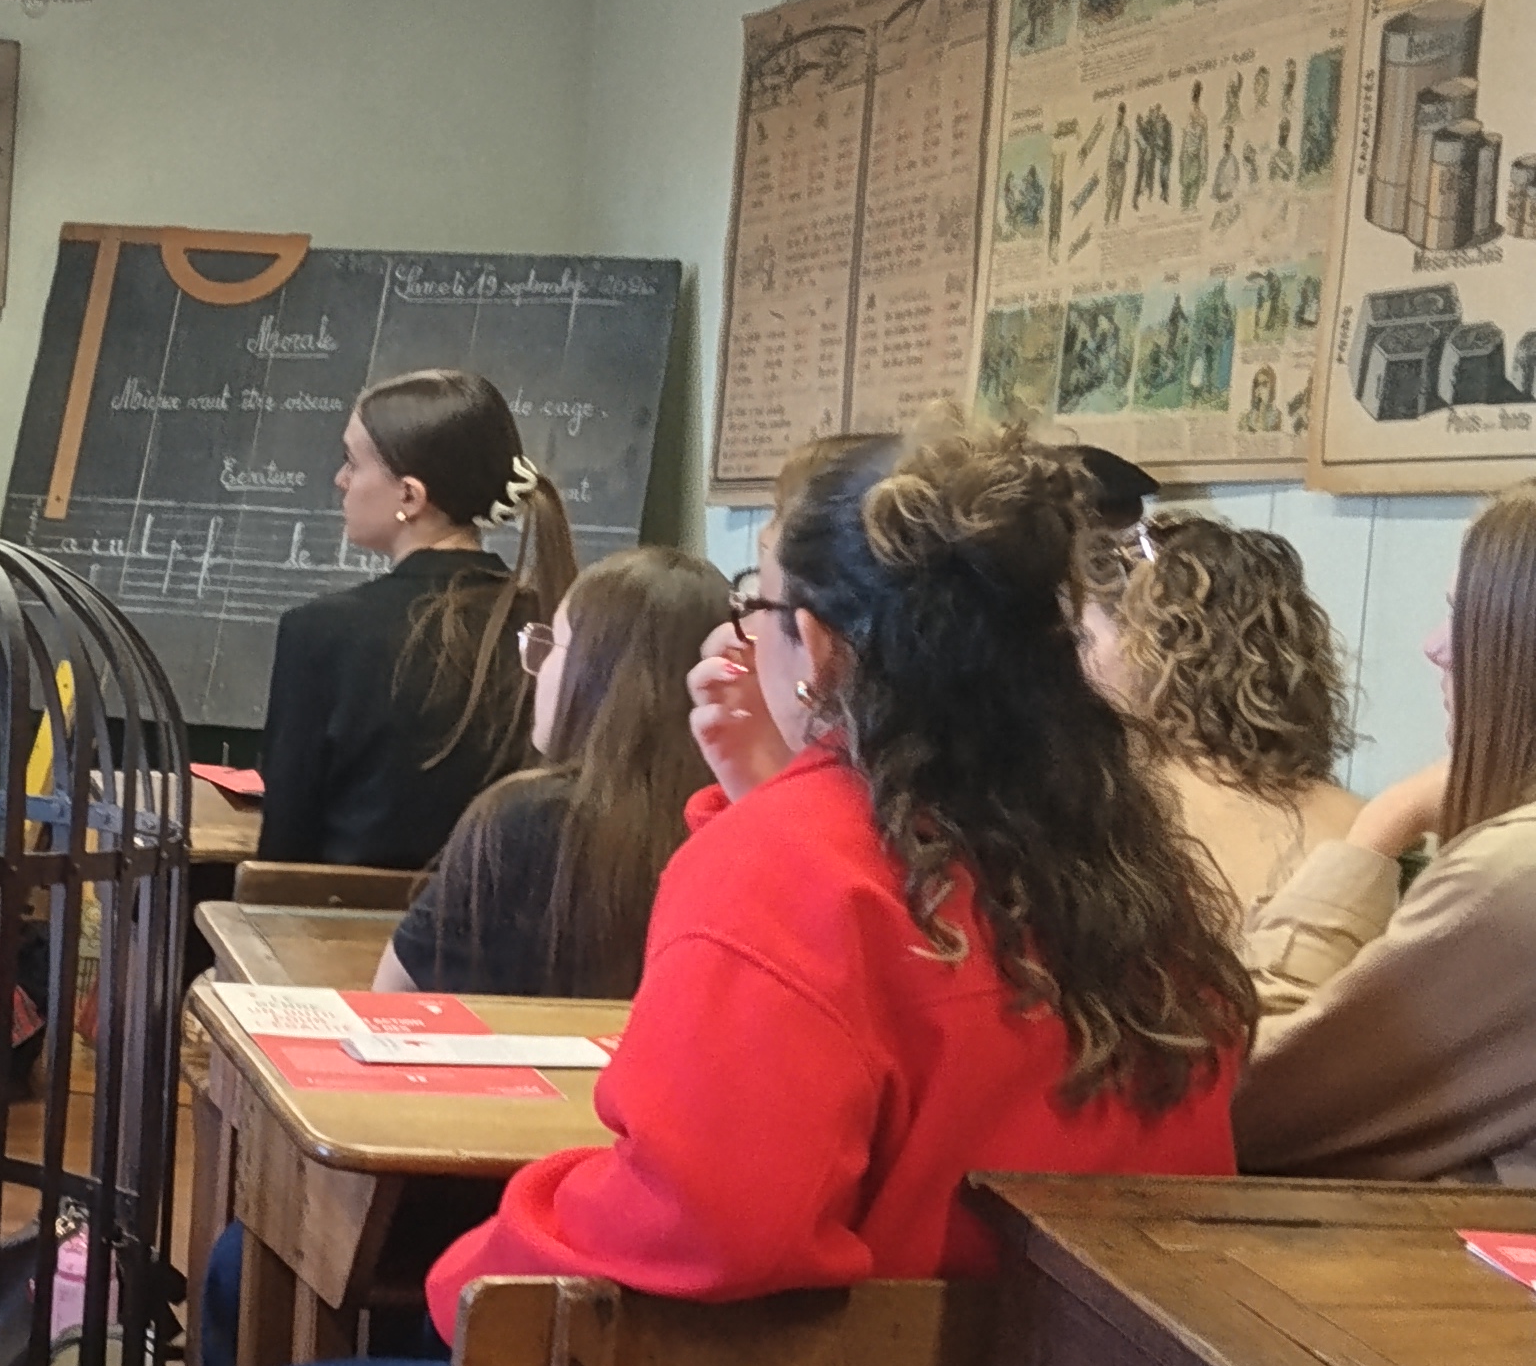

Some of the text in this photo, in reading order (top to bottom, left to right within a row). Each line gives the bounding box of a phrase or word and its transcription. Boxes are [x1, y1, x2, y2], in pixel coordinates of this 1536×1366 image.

[246, 314, 337, 354] Morale
[111, 375, 181, 410] Mieux
[187, 383, 231, 411] vaut
[282, 391, 344, 412] oiseau
[509, 387, 534, 417] de
